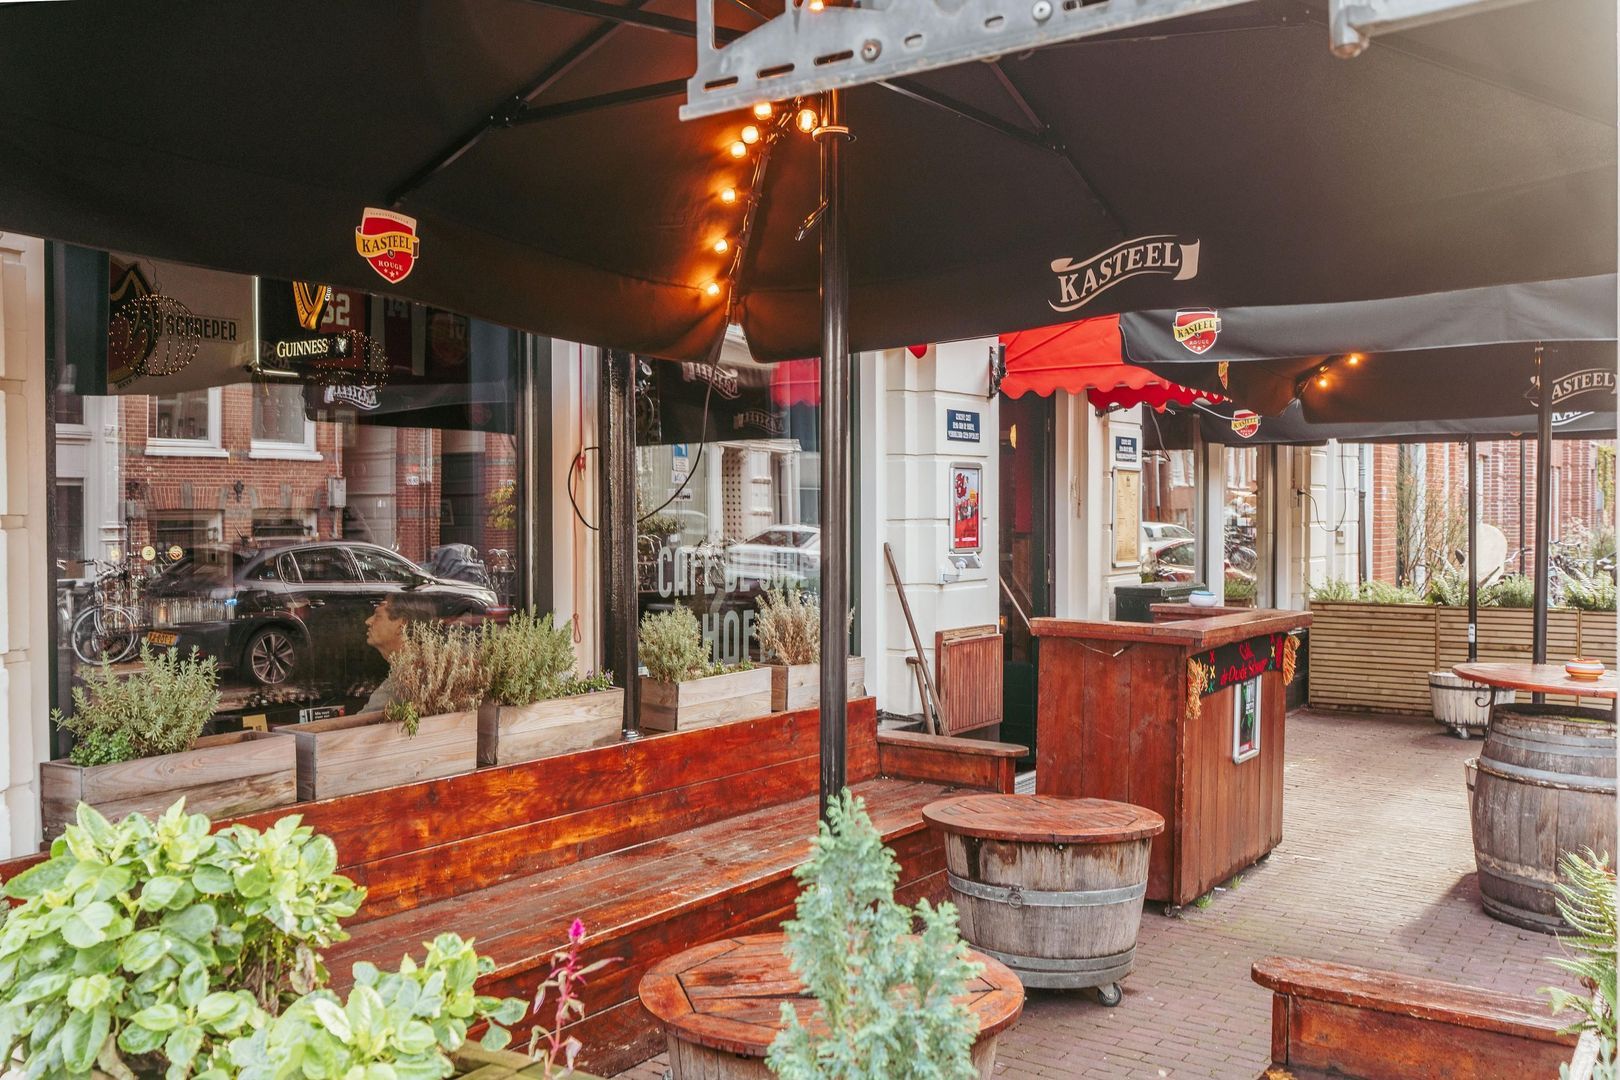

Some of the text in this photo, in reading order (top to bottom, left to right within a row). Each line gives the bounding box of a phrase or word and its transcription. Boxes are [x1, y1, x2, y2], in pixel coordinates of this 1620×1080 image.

[362, 235, 412, 253] KASTEEL
[378, 260, 404, 271] ROUGE
[1057, 242, 1180, 303] KASTEEL
[1176, 319, 1215, 338] KASTEEL
[276, 338, 329, 357] GUINNESS
[1552, 372, 1614, 400] ASTEEL
[658, 546, 716, 598] CAFE
